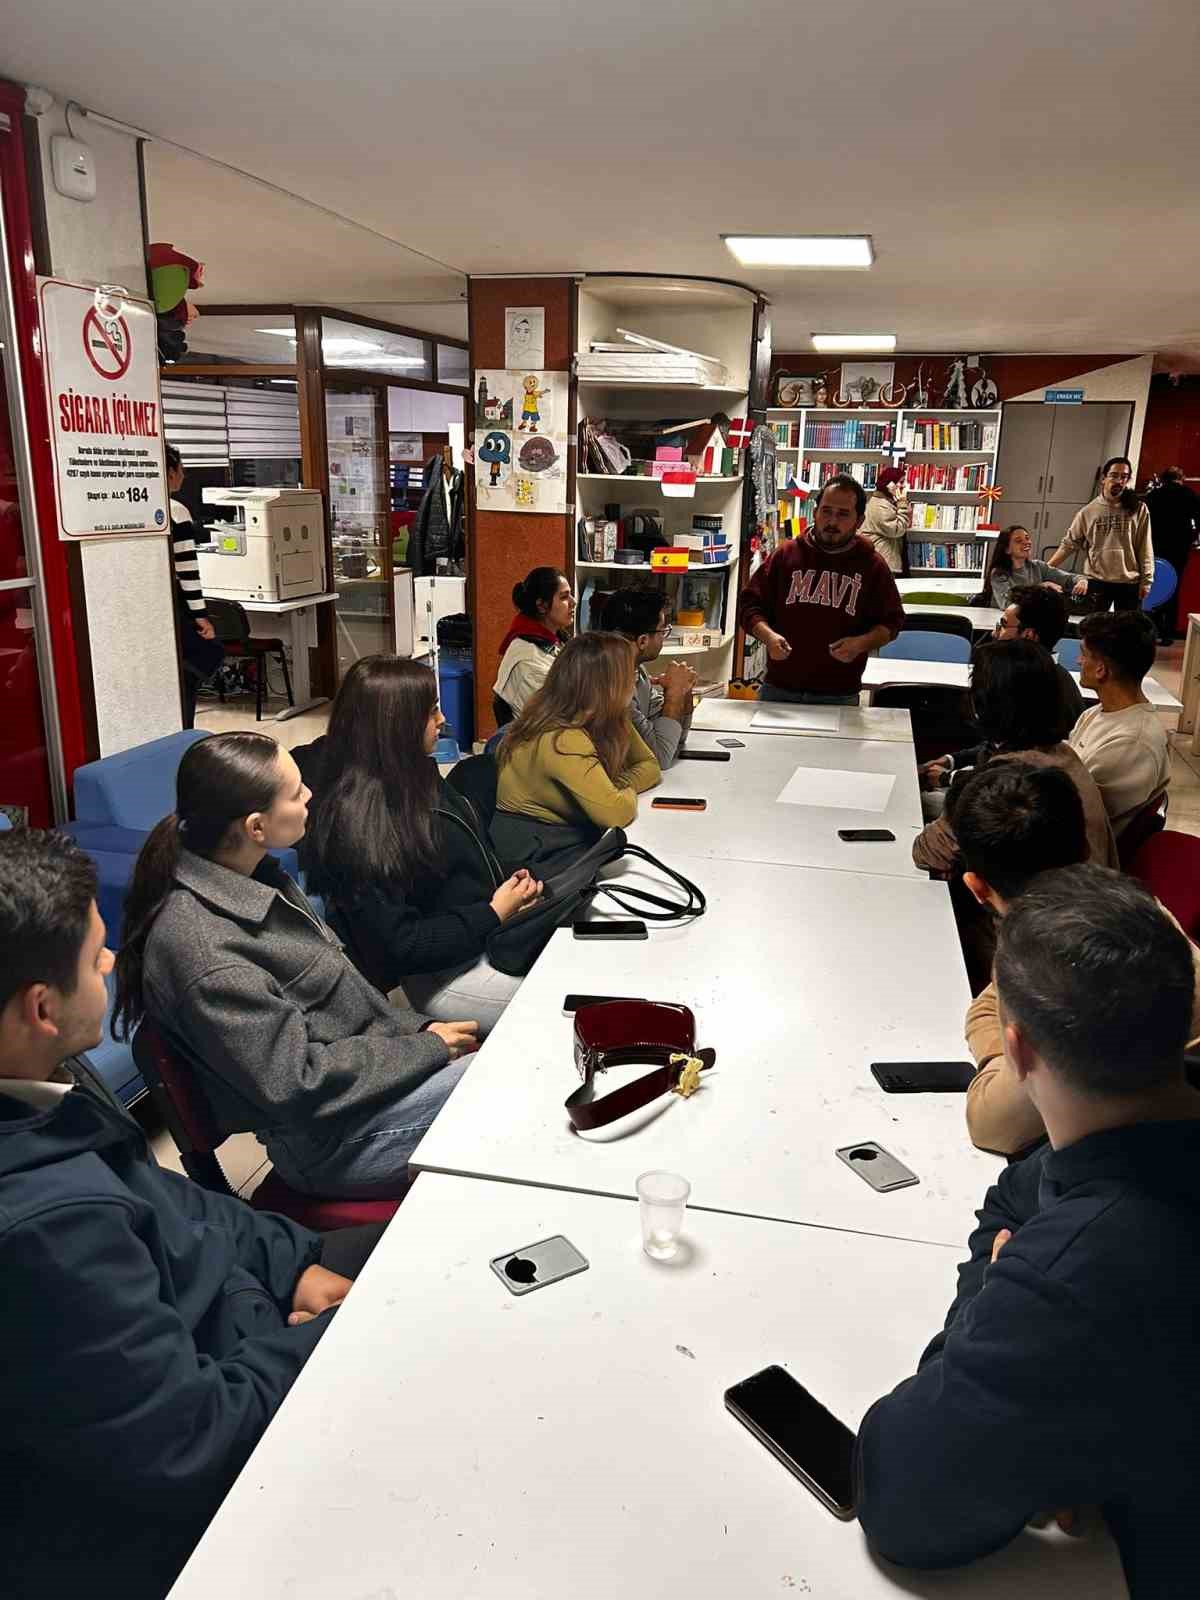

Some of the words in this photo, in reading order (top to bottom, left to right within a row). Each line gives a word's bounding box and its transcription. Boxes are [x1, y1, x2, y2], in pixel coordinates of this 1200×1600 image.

[58, 388, 112, 434] SİGARA
[112, 393, 158, 440] İÇİLMEZ
[126, 487, 149, 503] 184
